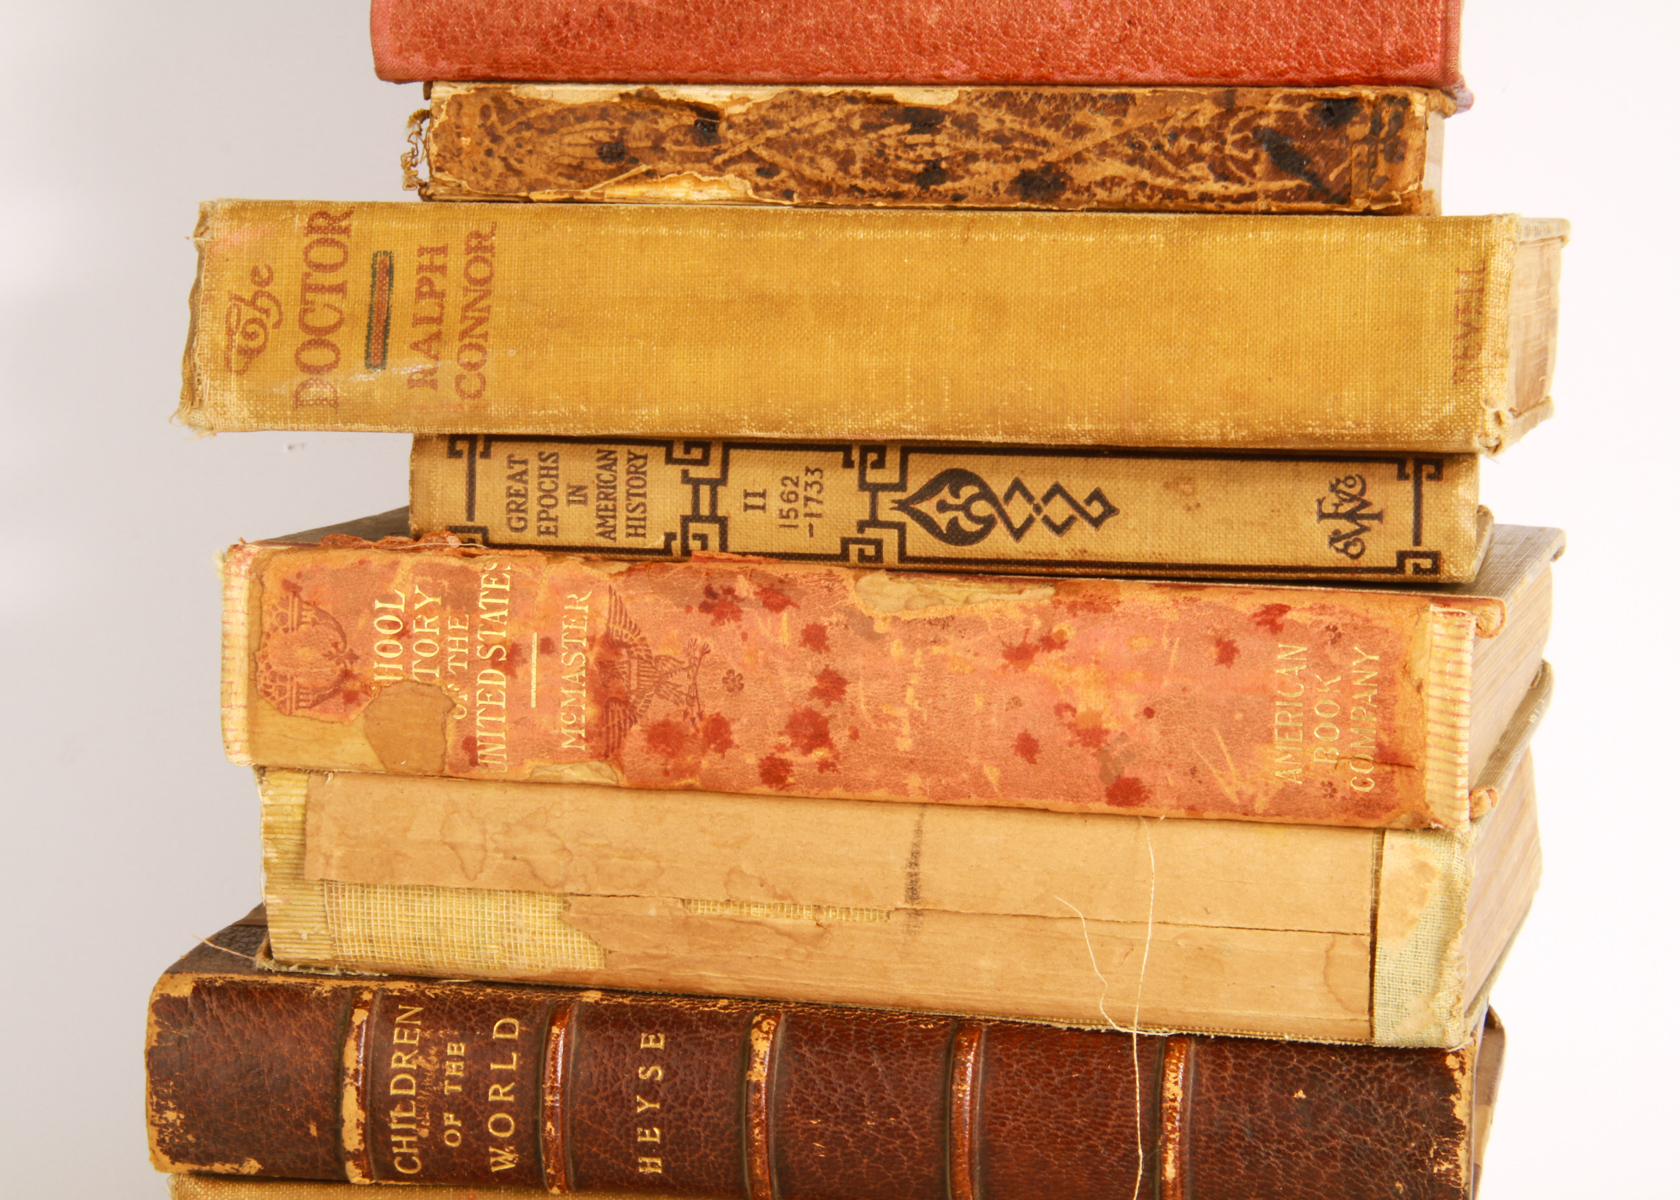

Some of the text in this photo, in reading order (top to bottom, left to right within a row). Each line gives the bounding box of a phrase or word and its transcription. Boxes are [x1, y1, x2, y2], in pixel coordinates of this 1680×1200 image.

[224, 263, 284, 376] The
[293, 205, 355, 410] DOCTOR
[407, 243, 449, 392] RALPH
[454, 221, 498, 401] CONNOR
[505, 453, 530, 535] GREAT
[536, 450, 560, 538] EPOCHS
[565, 482, 589, 508] IN
[595, 448, 618, 542] AMERICAN
[625, 449, 648, 540] HISTORY
[742, 488, 768, 514] II
[777, 474, 800, 530] 1562
[373, 588, 405, 682] HOOL
[411, 584, 442, 682] TORY
[447, 612, 470, 675] THE
[475, 667, 508, 774] UNITED
[1274, 642, 1308, 786] AMERICAN
[1313, 673, 1342, 765] BOOK
[1349, 645, 1380, 793] COMPANY
[389, 1003, 425, 1175] CHILDREN
[443, 1041, 466, 1148] OF THE
[487, 1016, 520, 1173] WORLD
[636, 1031, 666, 1175] HEYSE
